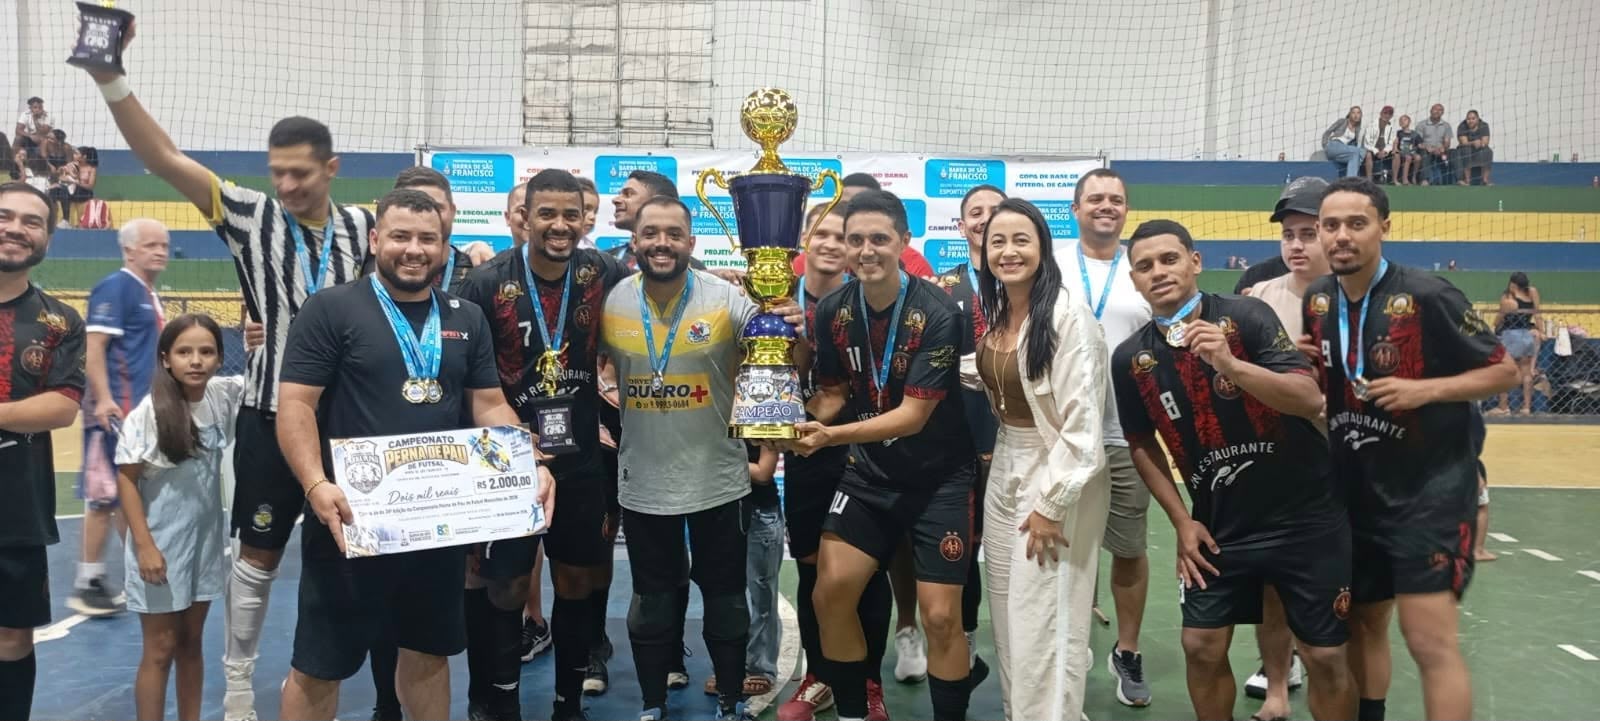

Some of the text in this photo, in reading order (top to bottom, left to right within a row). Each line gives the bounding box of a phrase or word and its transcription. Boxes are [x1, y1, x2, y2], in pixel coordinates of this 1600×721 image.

[518, 320, 532, 347] 7
[1321, 340, 1333, 368] 9
[515, 369, 592, 408] JN REURANTE
[734, 404, 792, 418] CAMPEÃO
[1159, 391, 1182, 421] 8
[388, 436, 454, 448] CAMPEONATO
[384, 446, 427, 475] PERNA
[427, 445, 443, 460] DE
[442, 444, 468, 465] PAU
[1198, 442, 1275, 472] ESTAURANTE
[388, 490, 414, 504] Dois
[417, 486, 432, 499] mil
[435, 487, 459, 498] reais
[477, 476, 531, 490] R$ 2.000,00
